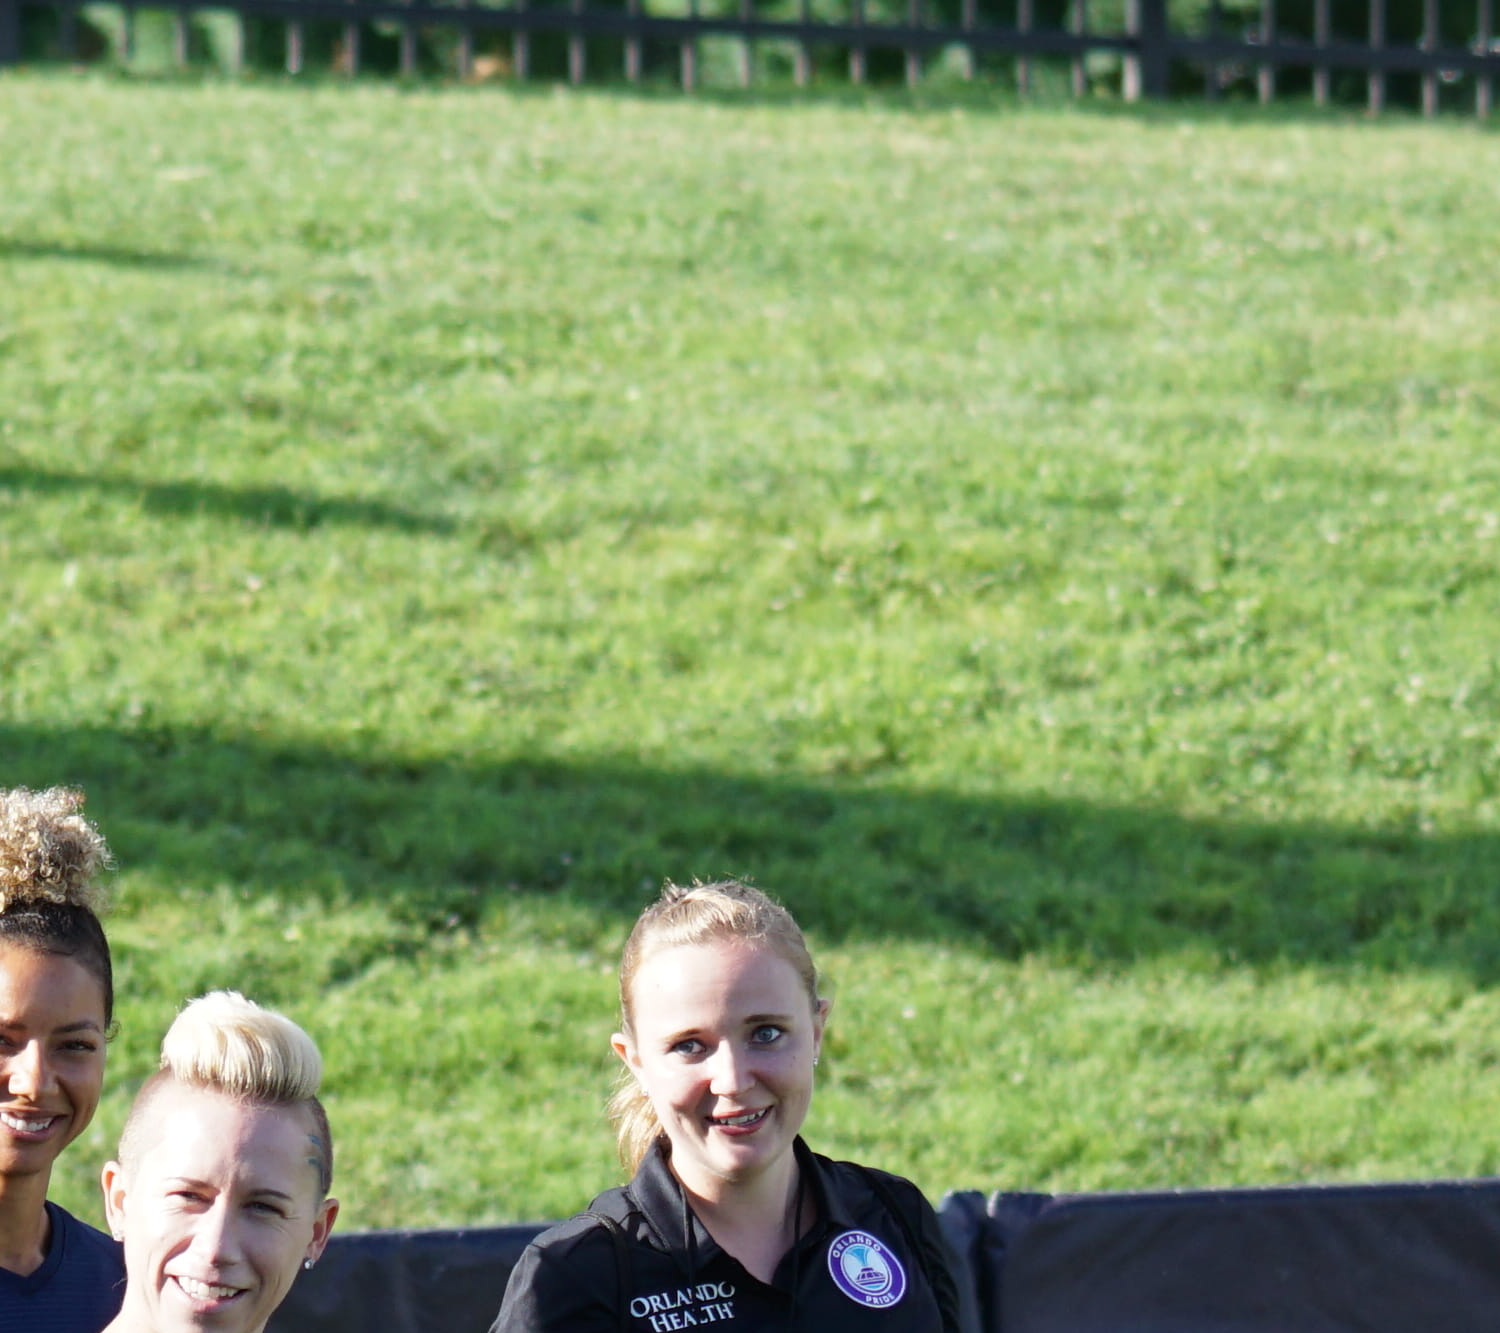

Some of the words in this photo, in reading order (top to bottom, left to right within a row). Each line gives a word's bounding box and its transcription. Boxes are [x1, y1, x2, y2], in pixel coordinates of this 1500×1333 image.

[832, 1234, 881, 1259] ORLANDO
[630, 1281, 736, 1319] ORLANDO
[865, 1292, 896, 1305] PRIDE
